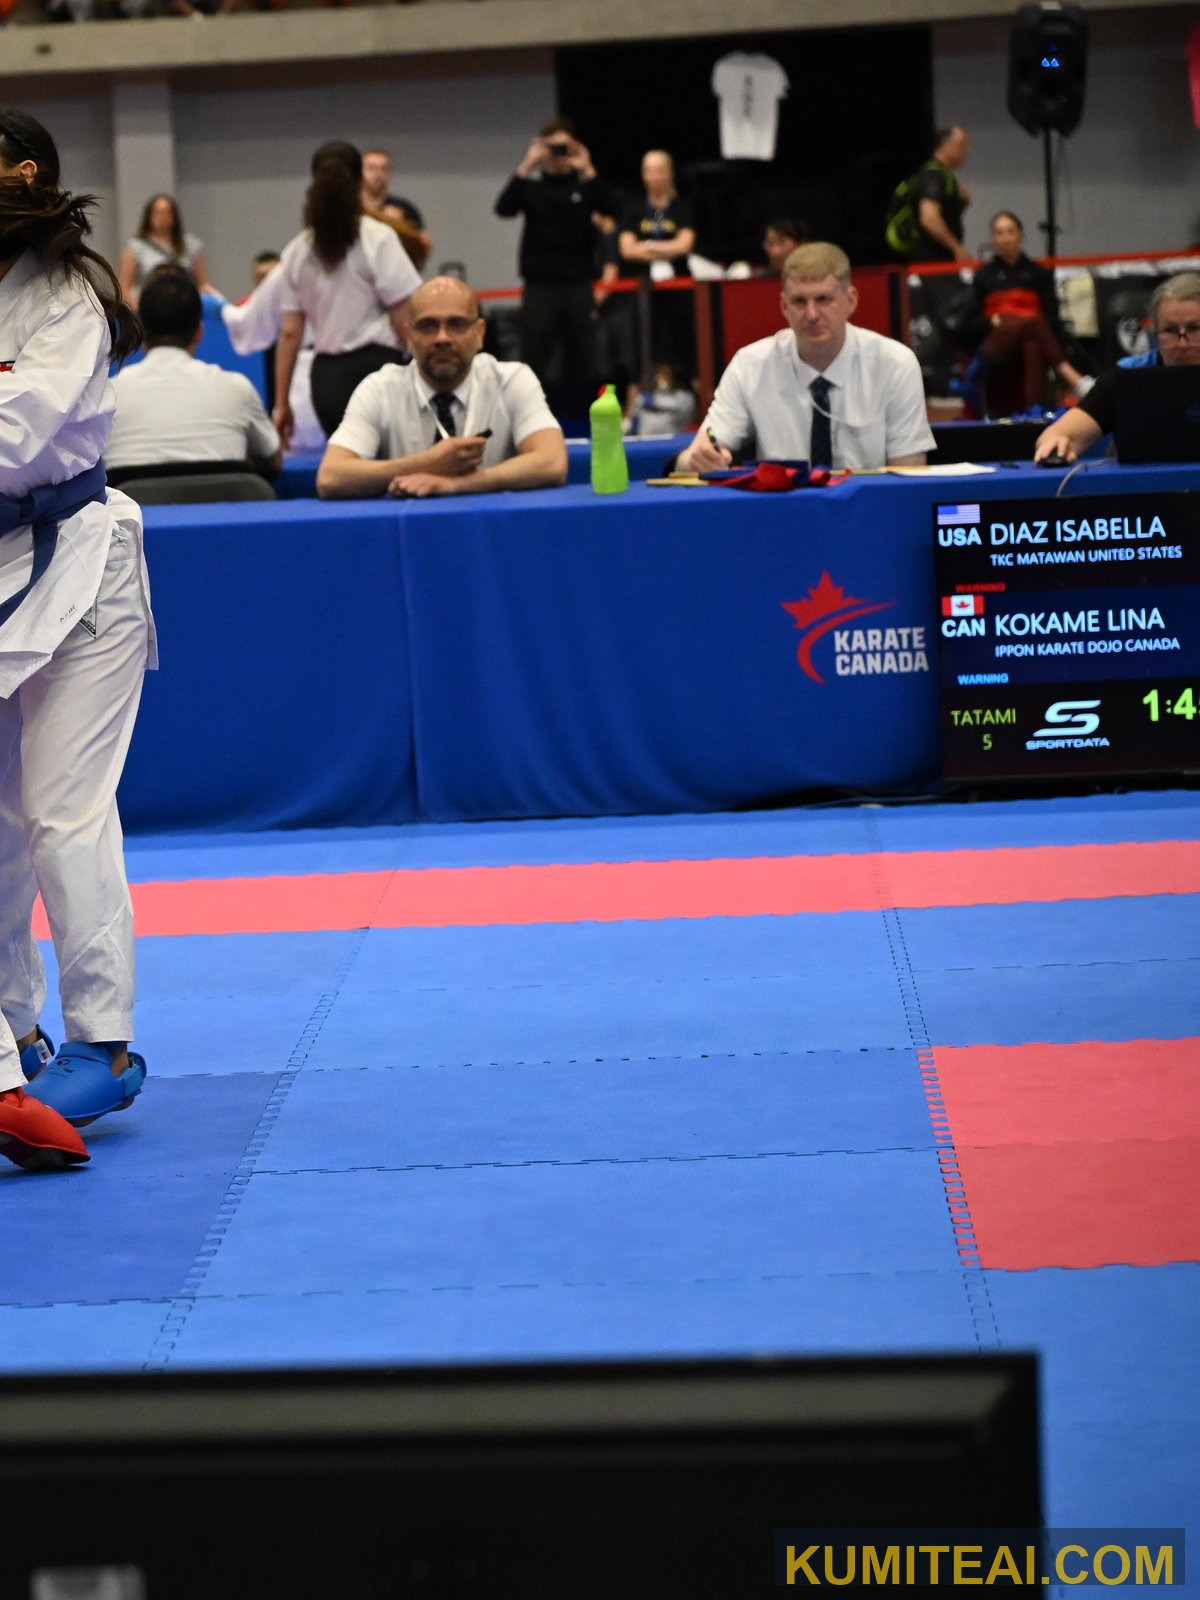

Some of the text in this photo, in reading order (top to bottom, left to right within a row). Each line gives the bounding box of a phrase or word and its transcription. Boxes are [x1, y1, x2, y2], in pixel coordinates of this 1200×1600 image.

[938, 527, 982, 547] USA
[990, 515, 1166, 546] DIAZ ISABELLA
[990, 545, 1183, 566] TKC MATAWAN UNITED STATES
[941, 618, 986, 637] CAN
[995, 607, 1166, 636] KOKAME LINA
[833, 626, 926, 653] KARATE
[995, 637, 1181, 658] IPPON KARATE DOJO CANADA
[835, 650, 930, 676] CANADA
[957, 673, 1009, 686] WARNING
[1142, 688, 1200, 722] 1:4
[950, 708, 1017, 727] TATAMI
[982, 733, 993, 751] 5
[1025, 737, 1110, 750] SPORTDATA
